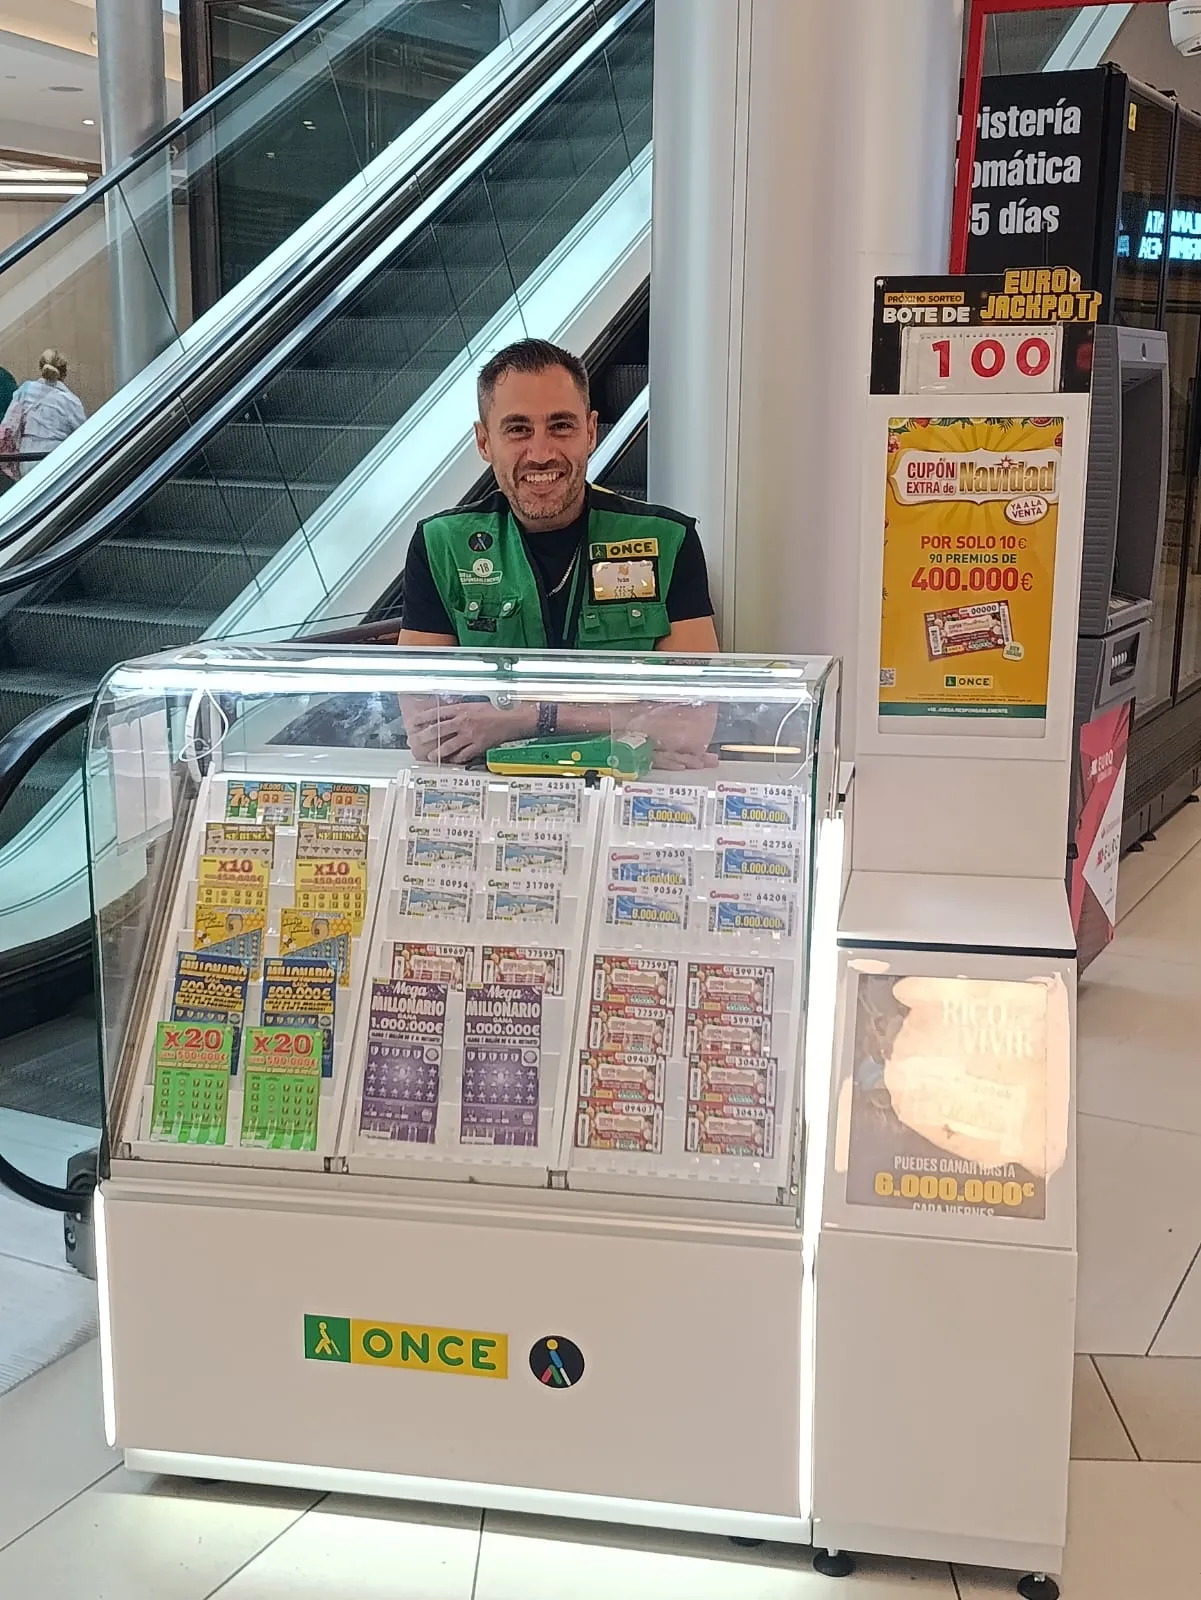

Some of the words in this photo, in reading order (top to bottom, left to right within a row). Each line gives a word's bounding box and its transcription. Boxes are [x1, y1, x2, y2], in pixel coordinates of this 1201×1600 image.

[998, 198, 1060, 235] días
[1004, 268, 1069, 294] EURO
[887, 293, 926, 304] PRÓXIMO
[928, 294, 962, 303] SORTEO
[979, 292, 1093, 321] JACKPOT
[883, 307, 940, 324] BOTE
[942, 307, 970, 323] DE
[931, 337, 1051, 378] 100
[906, 458, 956, 480] CUPÓN
[958, 461, 1056, 494] Navidad
[906, 481, 940, 495] EXTRA
[941, 482, 954, 494] de
[1010, 502, 1022, 513] YA
[1023, 501, 1030, 511] A
[1031, 499, 1043, 509] LA
[1011, 507, 1043, 519] VENTA
[610, 542, 653, 556] ONCE
[920, 535, 951, 549] POR
[956, 535, 995, 550] SOLO
[928, 552, 942, 564] 90
[945, 553, 999, 565] PREMIOS
[1002, 553, 1017, 565] DE
[911, 566, 1033, 591] 400.000€
[958, 677, 990, 686] ONCE
[446, 828, 474, 838] 10692
[440, 880, 469, 889] 80954
[393, 981, 429, 999] Mega
[486, 984, 523, 1002] Mega
[371, 995, 445, 1016] MILLONARIO
[466, 1000, 541, 1018] MILLONARIO
[371, 1016, 443, 1034] 1.000.000€
[466, 1022, 541, 1036] 1.000.000€
[164, 1028, 222, 1052] x20
[253, 1033, 312, 1055] x20
[894, 1155, 938, 1171] PUEDES
[978, 1162, 1016, 1178] HASTA
[874, 1171, 1036, 1206] 6.000.000€
[912, 1201, 944, 1214] CADA
[362, 1327, 497, 1371] ONCE
